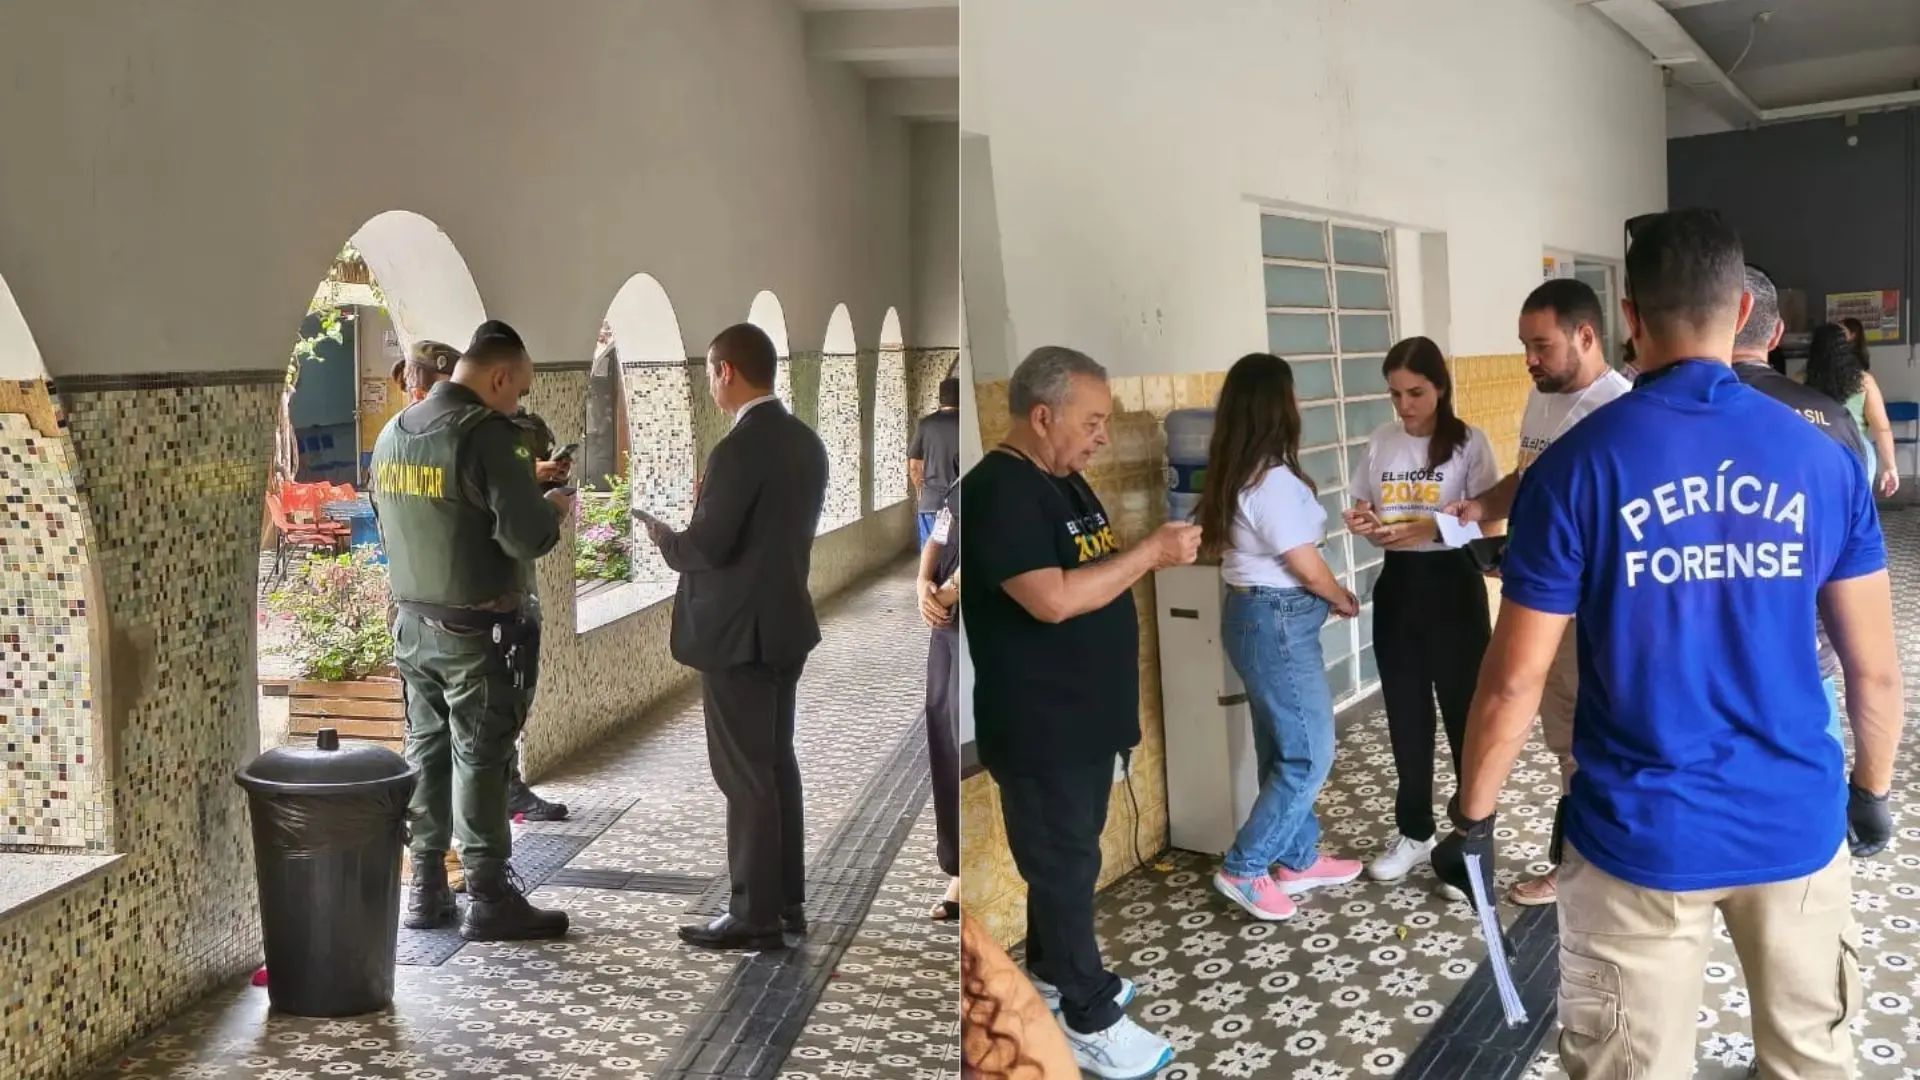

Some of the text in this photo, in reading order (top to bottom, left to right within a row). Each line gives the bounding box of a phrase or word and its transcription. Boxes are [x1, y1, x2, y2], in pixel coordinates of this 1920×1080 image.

[1795, 408, 1831, 427] SIL
[1381, 482, 1441, 505] 2026
[1620, 460, 1806, 542] PERÍCIA
[1625, 542, 1804, 587] FORENSE
